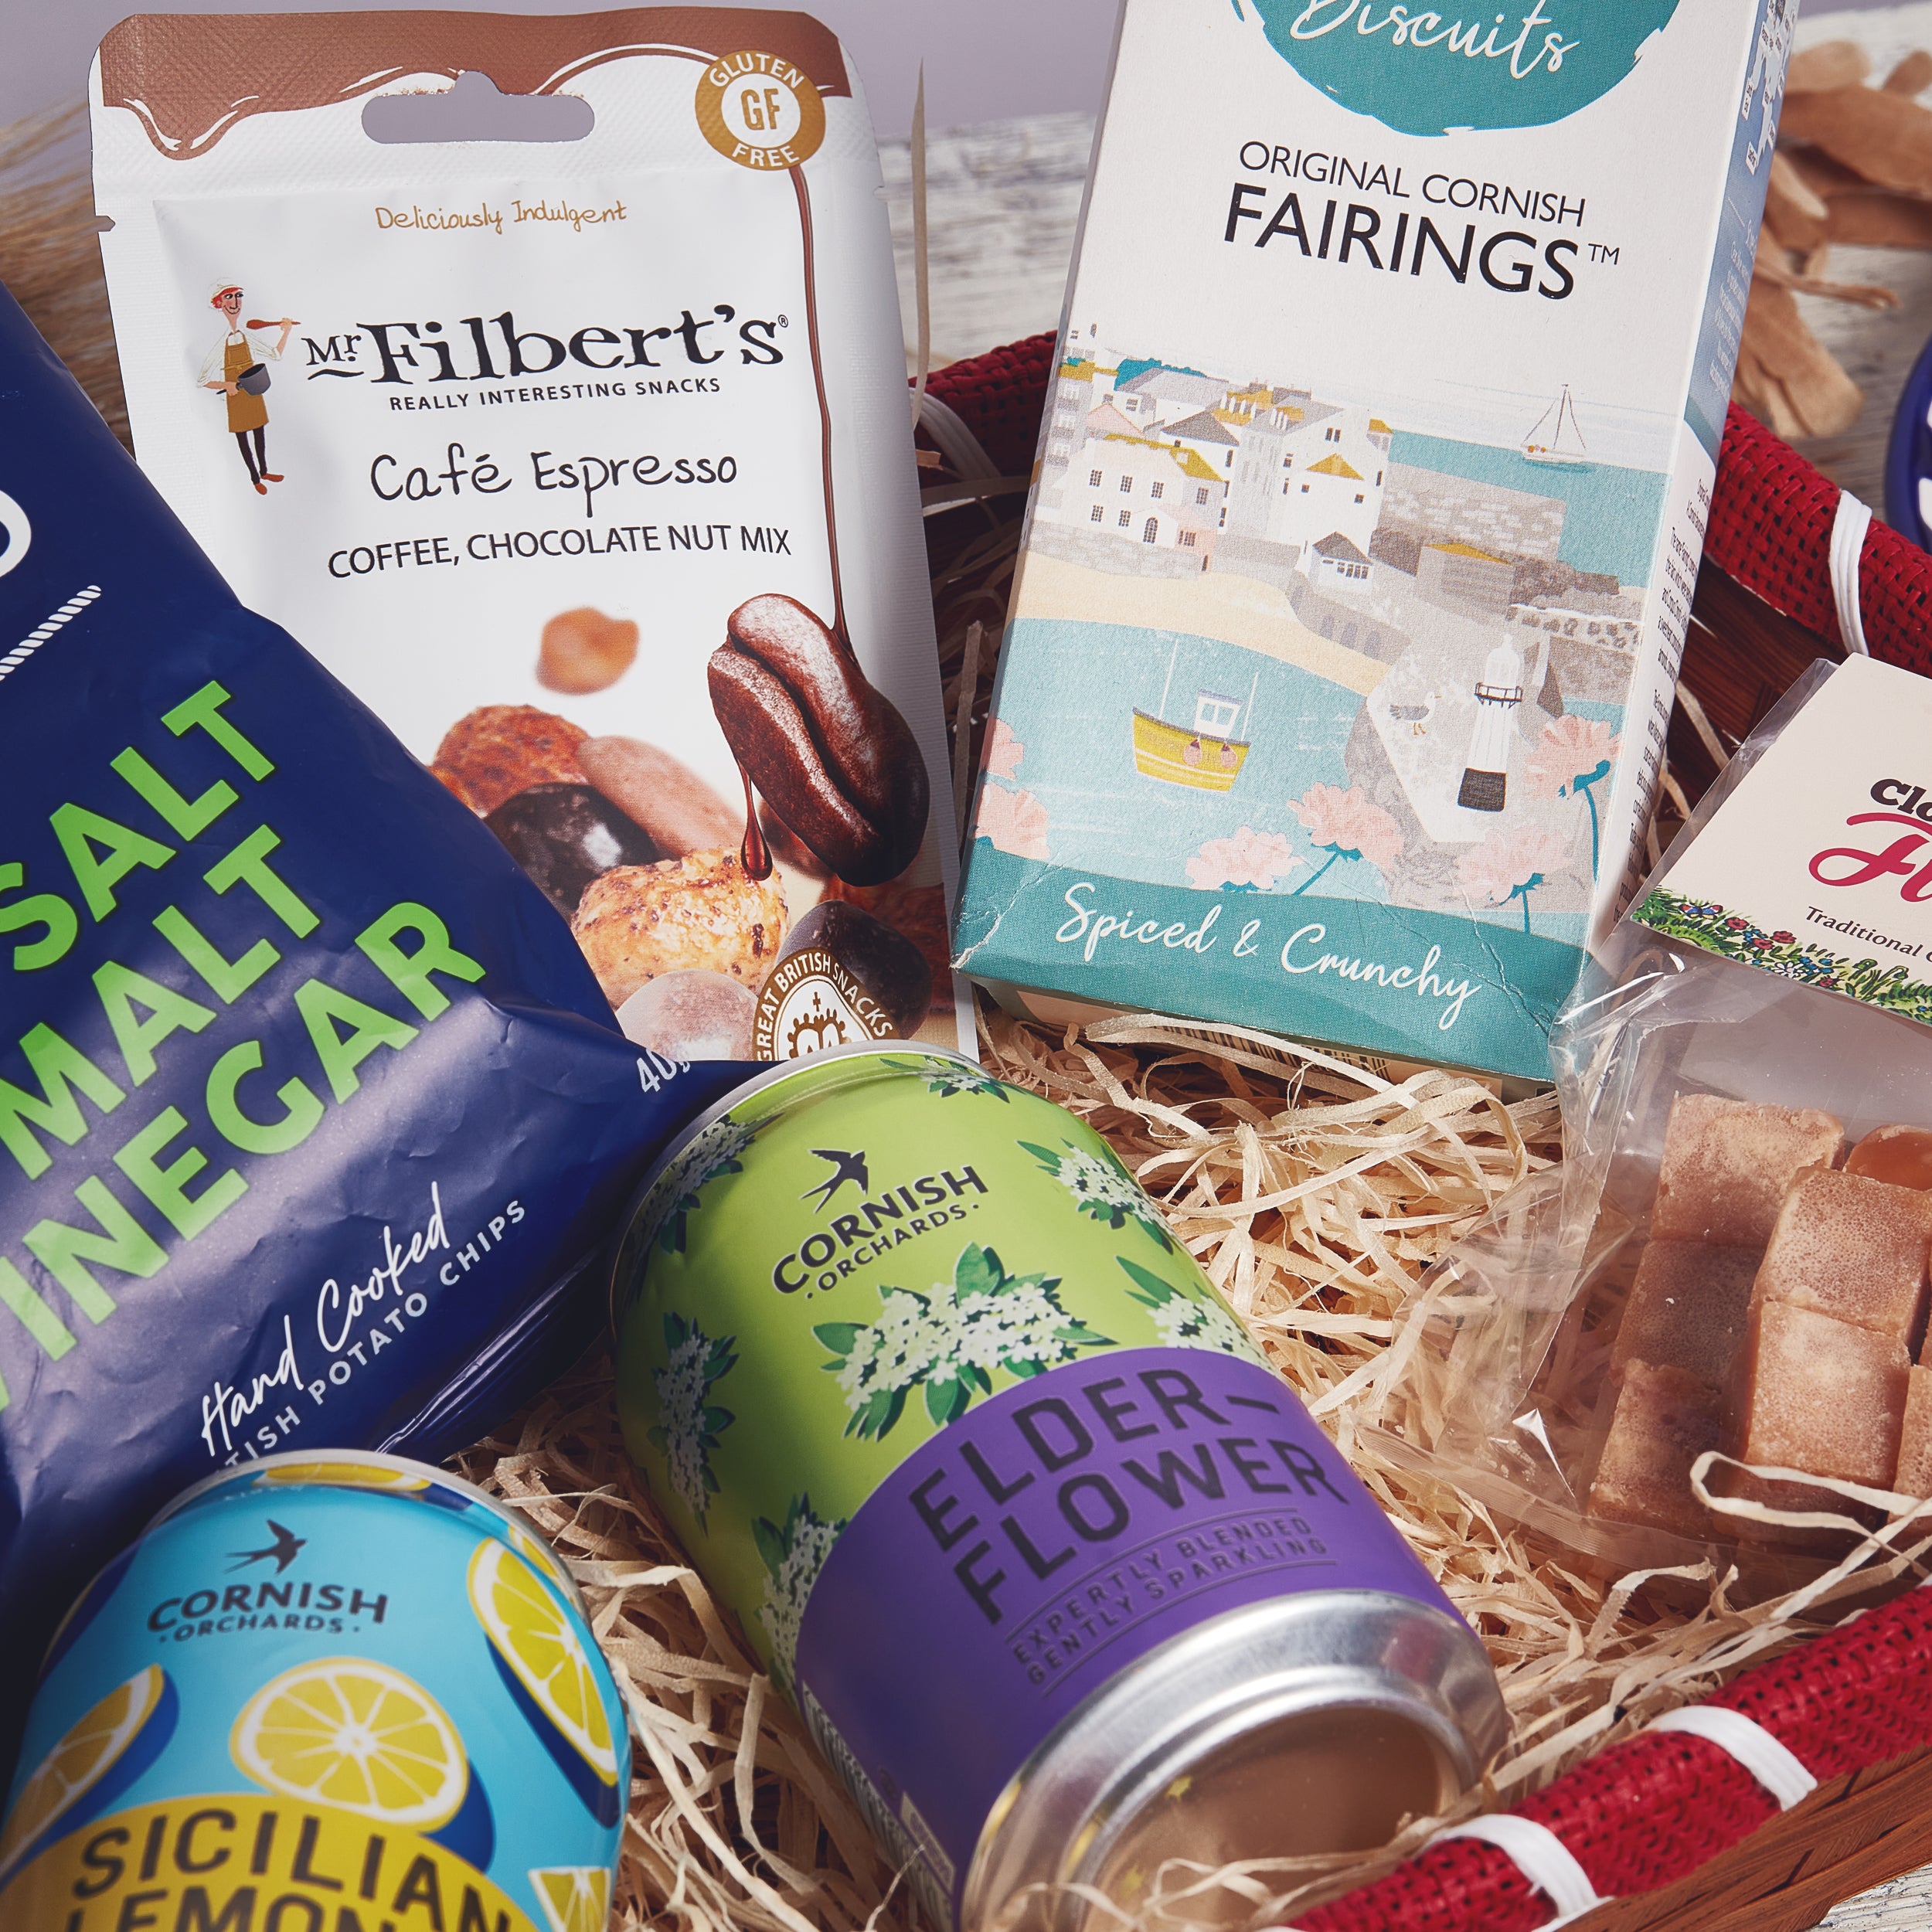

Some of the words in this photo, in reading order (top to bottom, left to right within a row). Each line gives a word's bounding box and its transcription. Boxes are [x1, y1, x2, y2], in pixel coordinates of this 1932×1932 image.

[709, 53, 804, 89] GLUTEN
[740, 87, 780, 131] GF
[732, 143, 800, 167] FREE
[1240, 141, 1410, 199] ORIGINAL
[1422, 174, 1586, 227] CORNISH
[376, 202, 503, 234] Deliciously
[512, 200, 628, 232] Indulgent
[390, 393, 470, 412] REALLY
[480, 381, 626, 406] INTERESTING
[635, 377, 722, 396] SNACKS
[370, 443, 512, 502] Café
[531, 451, 738, 519] Espresso
[328, 536, 460, 579] COFFEE,
[466, 526, 662, 562] CHOCOLATE
[669, 525, 732, 551] NUT
[740, 526, 792, 555] MIX
[0, 680, 275, 971] SALT
[1056, 883, 1223, 962] Spiced
[1233, 920, 1261, 957] &
[1281, 923, 1482, 1030] Crunchy
[1806, 906, 1923, 957] Traditional
[0, 824, 321, 1180] MALT
[757, 988, 780, 1061] GREAT
[774, 951, 831, 993] BRITISH
[832, 962, 893, 1037] SNACKS
[0, 901, 486, 1412] INEGAR
[773, 1165, 988, 1294] CORNISH
[202, 1315, 304, 1457] Hand
[318, 1181, 450, 1352] Cooked
[308, 1292, 428, 1406] POTATO
[440, 1200, 526, 1286] CHIPS
[953, 1437, 1350, 1626] FLOWER
[1012, 1549, 1163, 1665] EXPERTLY
[1175, 1515, 1312, 1559] BLENDED
[147, 1582, 388, 1633] CORNISH
[1026, 1594, 1134, 1685] GENTLY
[1144, 1537, 1328, 1600] SPARKLING
[73, 1808, 512, 1932] SICILIAN
